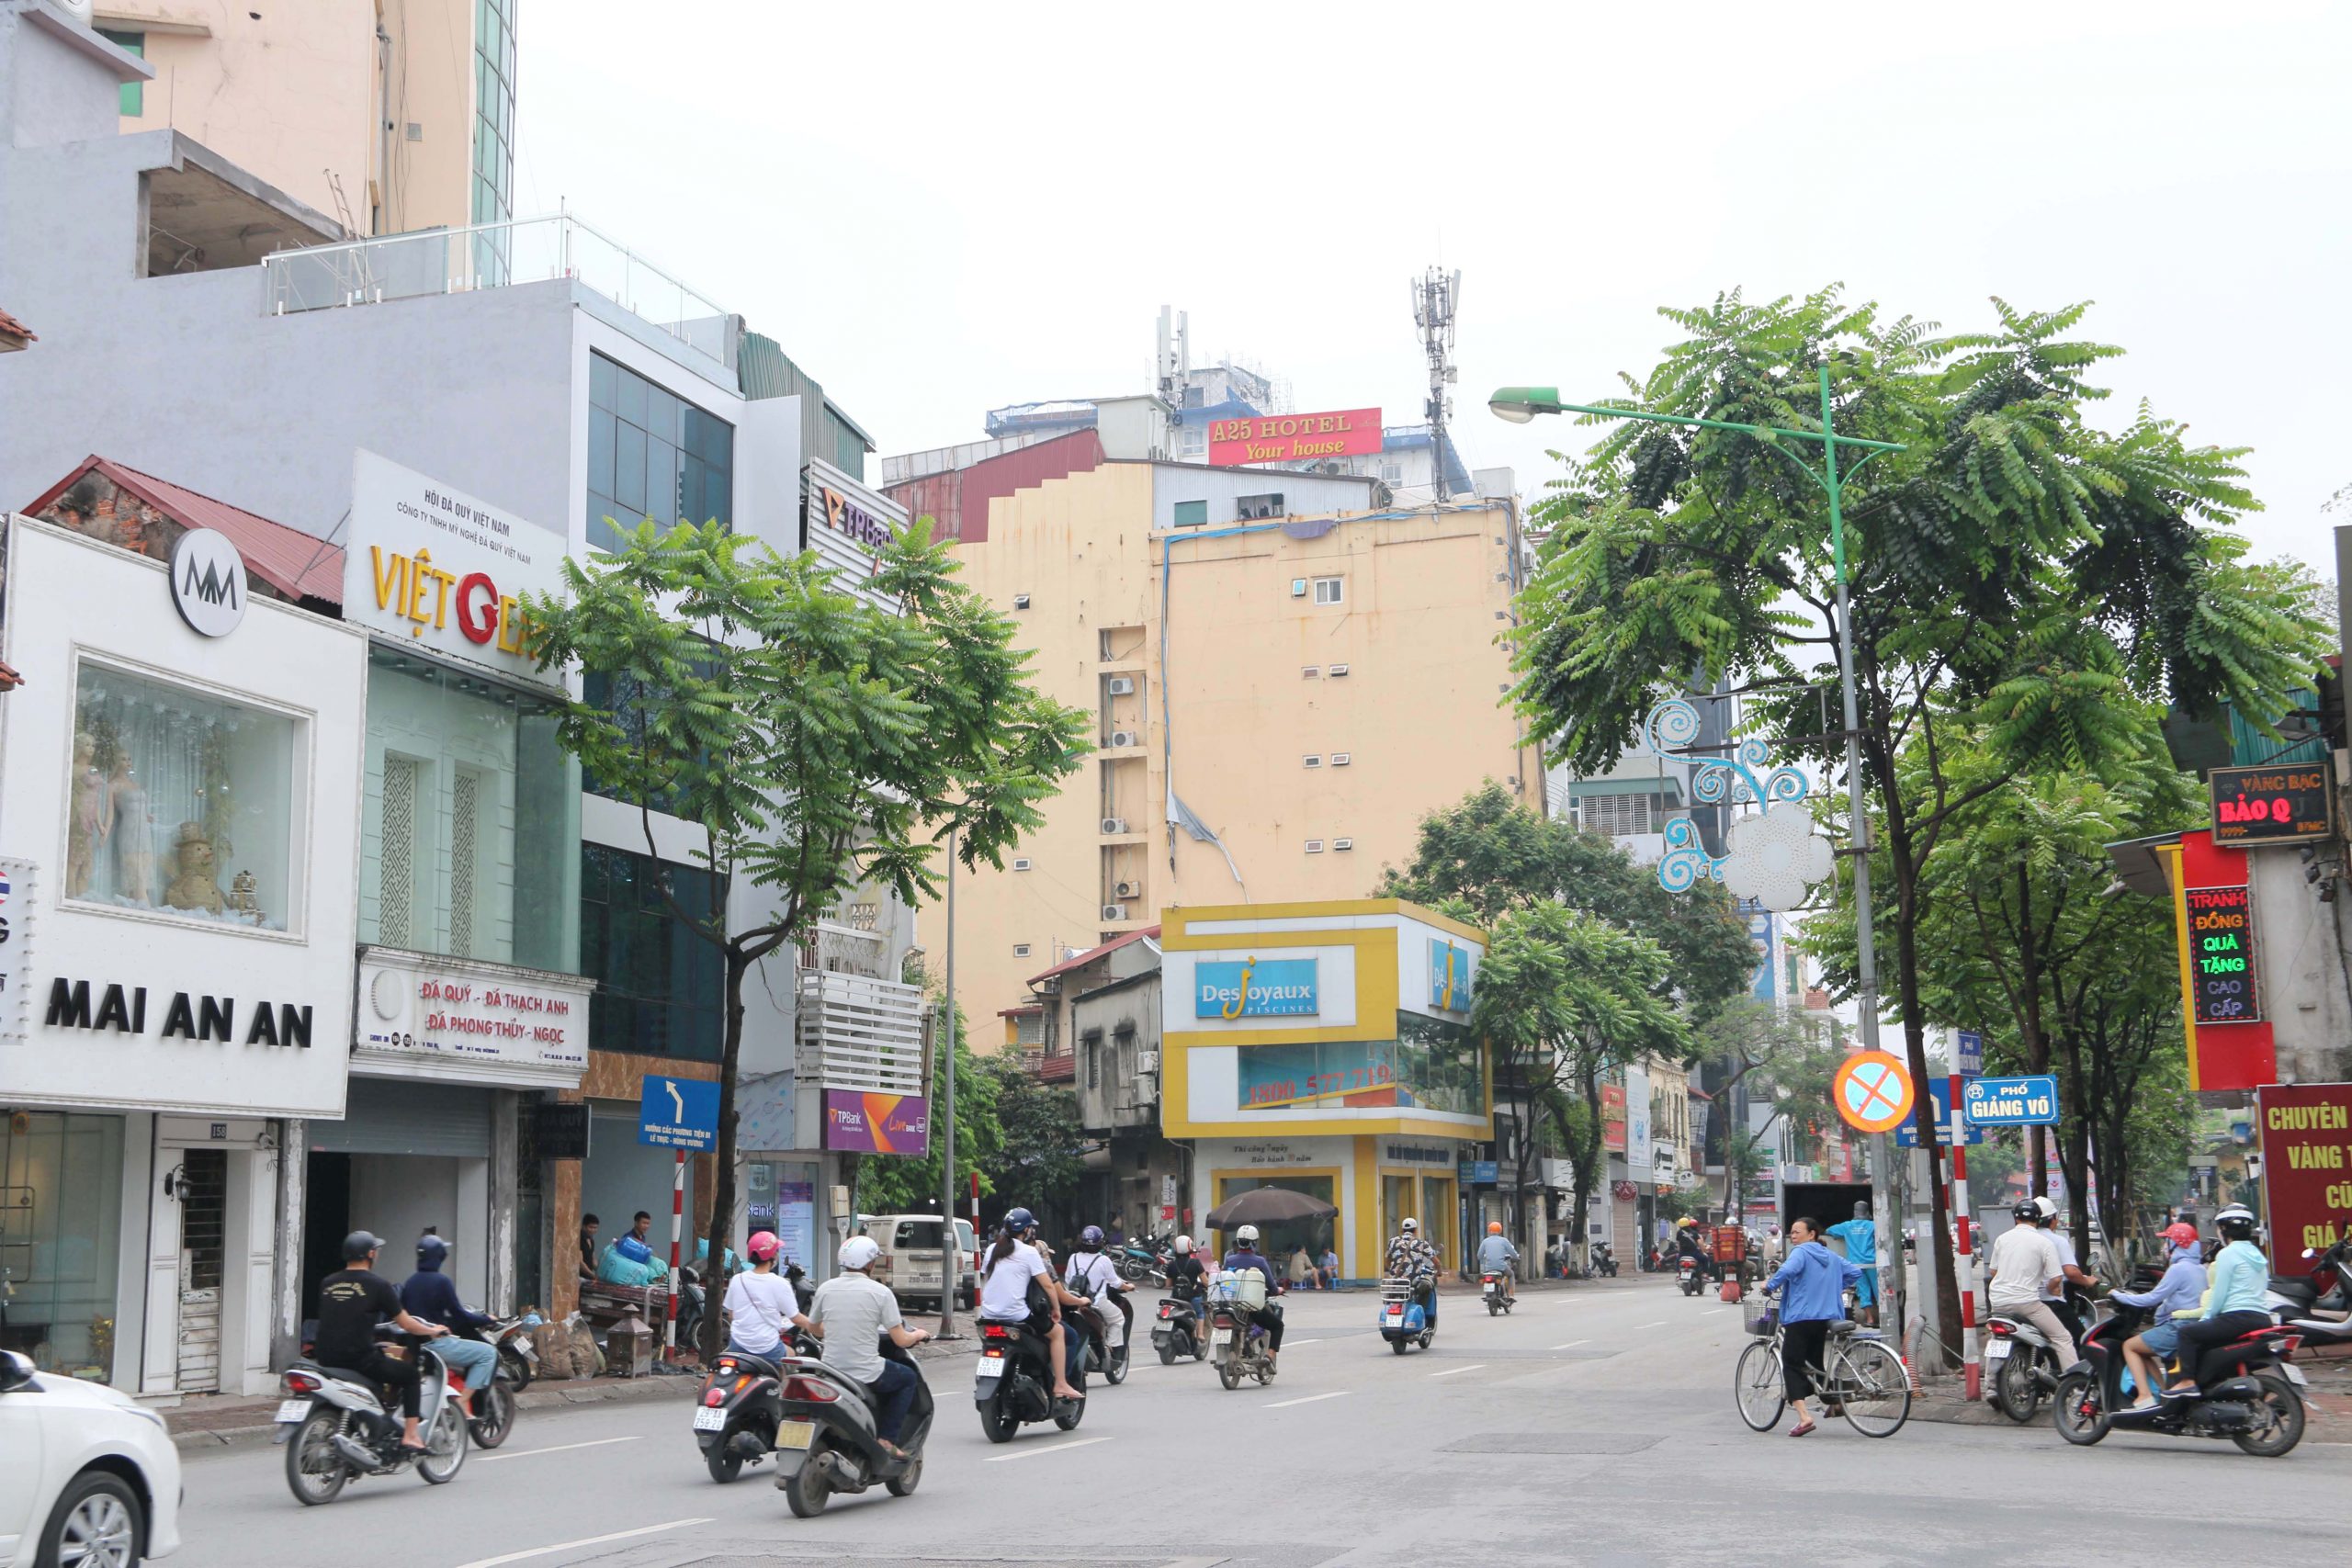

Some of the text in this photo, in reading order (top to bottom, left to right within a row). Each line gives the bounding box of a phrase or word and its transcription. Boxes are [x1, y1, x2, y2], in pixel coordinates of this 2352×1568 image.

[1213, 415, 1352, 443] A25 HOTEL
[1246, 439, 1345, 460] Your house
[424, 489, 510, 537] HỘI ĐÁ QUÝ VIỆT NAM
[844, 501, 899, 552] TPBan
[397, 500, 419, 518] CÔNG
[420, 511, 429, 522] TY
[429, 514, 447, 531] TNHH
[516, 552, 531, 566] NAM
[2241, 773, 2322, 792] VÀNG BẠC
[2219, 793, 2268, 823] BẢO
[2192, 892, 2245, 908] TRANH
[2203, 933, 2239, 952] QUÀ
[2200, 955, 2245, 975] TẶNG
[421, 979, 569, 1015] ĐÁ QUÝ ĐÁ THẠCH ANH
[2207, 980, 2242, 995] CAO
[45, 976, 313, 1048] MAI AN AN
[1248, 1005, 1313, 1014] PISCINES
[2210, 998, 2243, 1017] CẤP
[427, 1010, 565, 1047] ĐÁ PHONG THỦY NGỌC
[1250, 1065, 1391, 1105] 1800 577 719
[2000, 1082, 2029, 1095] PHỐ
[838, 1111, 862, 1124] TPBank
[1972, 1096, 2050, 1118] GIẢNG VÕ
[2267, 1101, 2348, 1131] CHUYÊN
[2287, 1141, 2343, 1169] VÀNG
[2302, 1220, 2337, 1249] GIÁ
